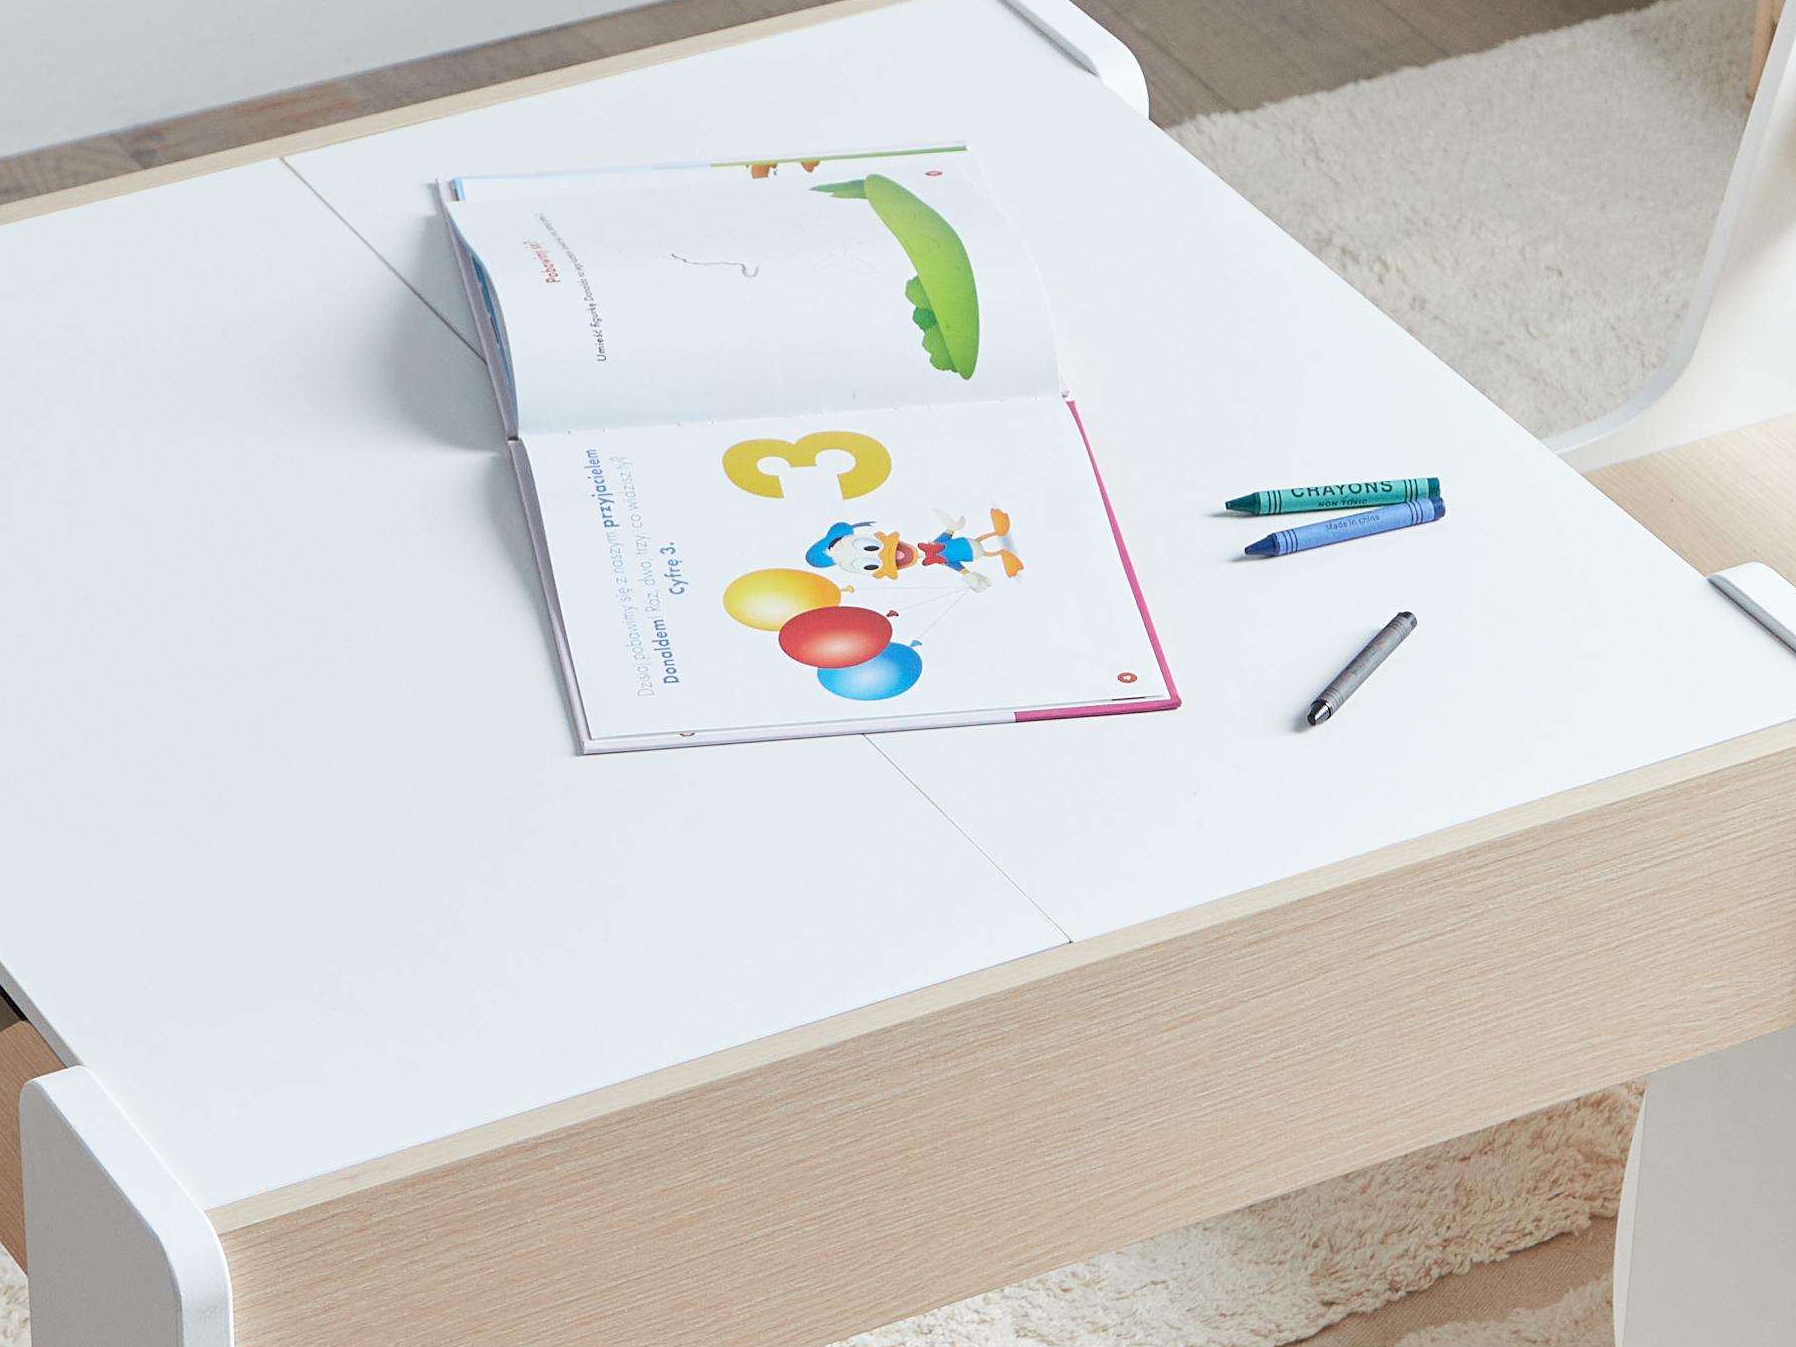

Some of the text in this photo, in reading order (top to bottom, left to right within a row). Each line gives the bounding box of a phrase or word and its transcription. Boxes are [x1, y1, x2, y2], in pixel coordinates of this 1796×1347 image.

[591, 330, 607, 362] Umieść
[722, 430, 892, 500] 3
[584, 448, 620, 528] przyjacielem
[618, 472, 639, 511] widzisz
[1291, 481, 1393, 498] CRAYONS
[630, 514, 644, 529] co
[606, 532, 624, 574] naszym
[659, 541, 689, 595] Cyfrę 3.
[615, 575, 628, 584] z
[616, 587, 633, 603] się
[622, 605, 648, 661] pobawimy
